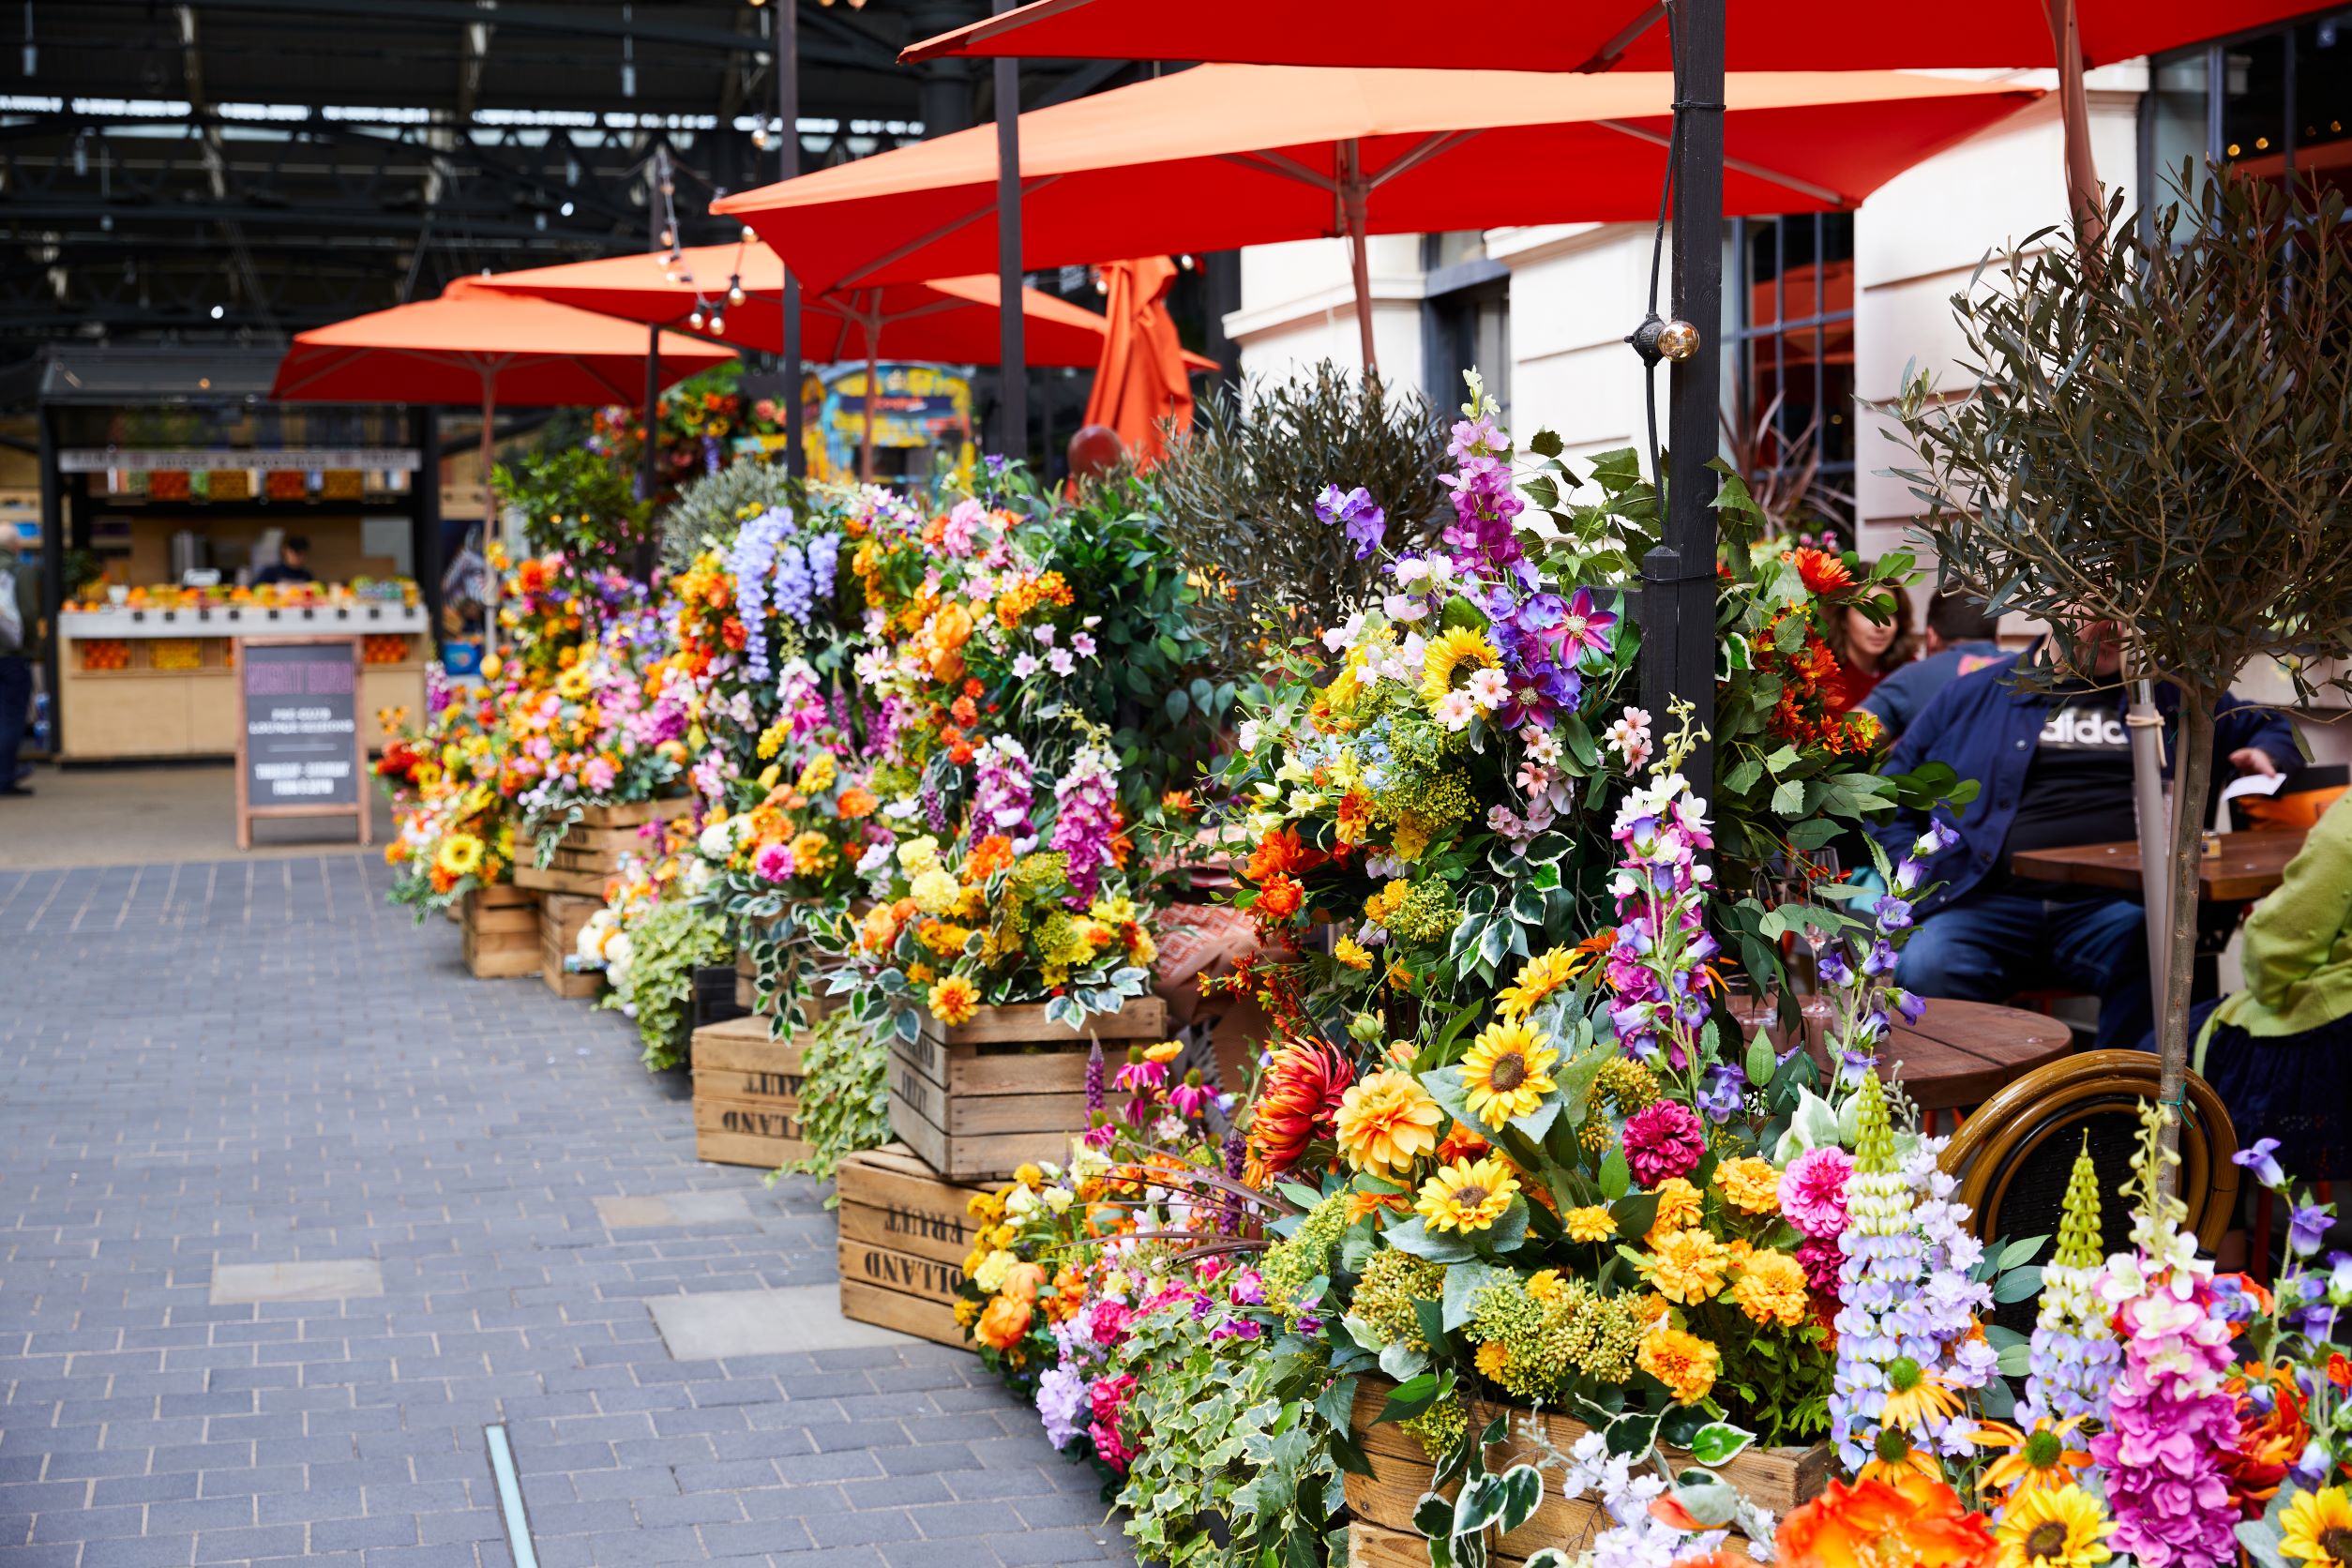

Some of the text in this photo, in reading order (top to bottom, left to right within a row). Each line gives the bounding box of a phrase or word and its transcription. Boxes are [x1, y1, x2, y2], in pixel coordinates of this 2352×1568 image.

[2039, 707, 2129, 745] dida
[742, 1072, 805, 1096] RUIT
[884, 1201, 964, 1245] FRUIT
[865, 1251, 967, 1296] OLLAND
